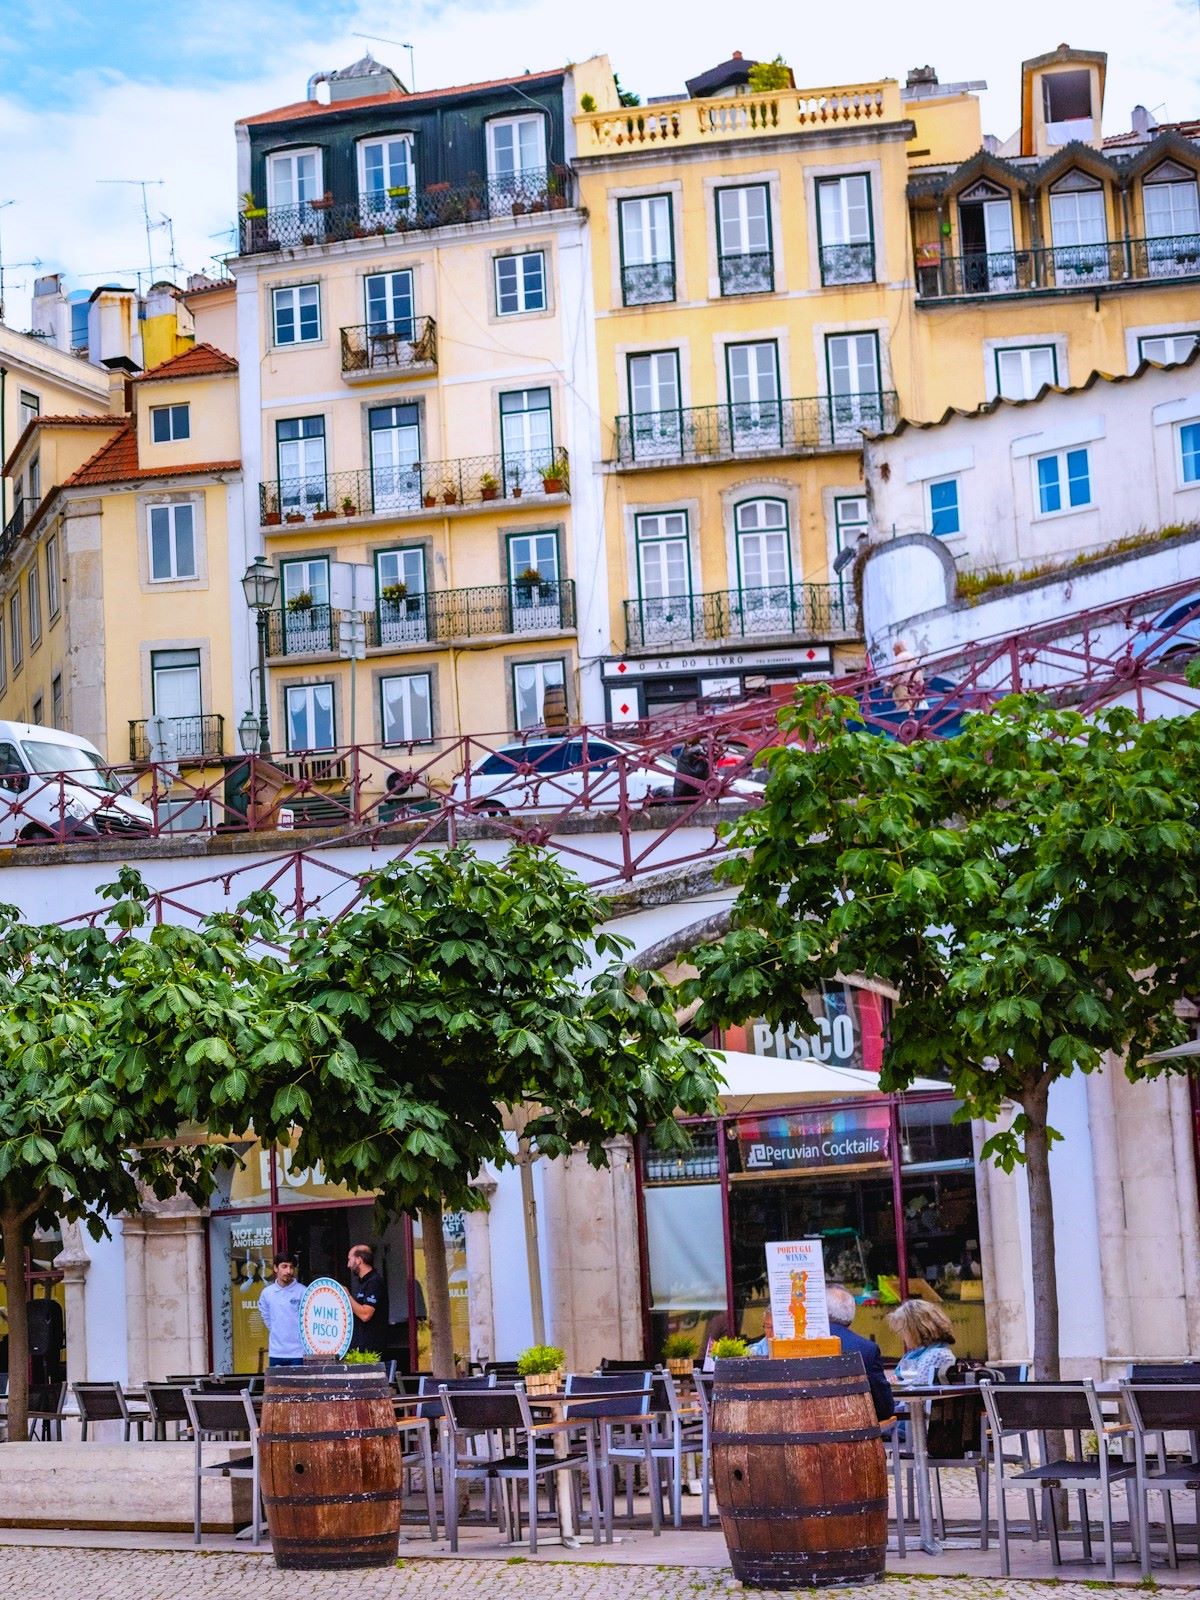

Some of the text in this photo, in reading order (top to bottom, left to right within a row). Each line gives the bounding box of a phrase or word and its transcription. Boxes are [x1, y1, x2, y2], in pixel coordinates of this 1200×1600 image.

[708, 655, 744, 666] LIVRO
[753, 1014, 855, 1061] PISCO
[766, 1137, 880, 1161] Peruvian Cocktails
[232, 1227, 272, 1240] NOT JUS
[233, 1238, 264, 1248] ANOTHER
[777, 1245, 812, 1254] PORTUGAL
[313, 1305, 339, 1321] WINE
[312, 1322, 339, 1338] PISCO
